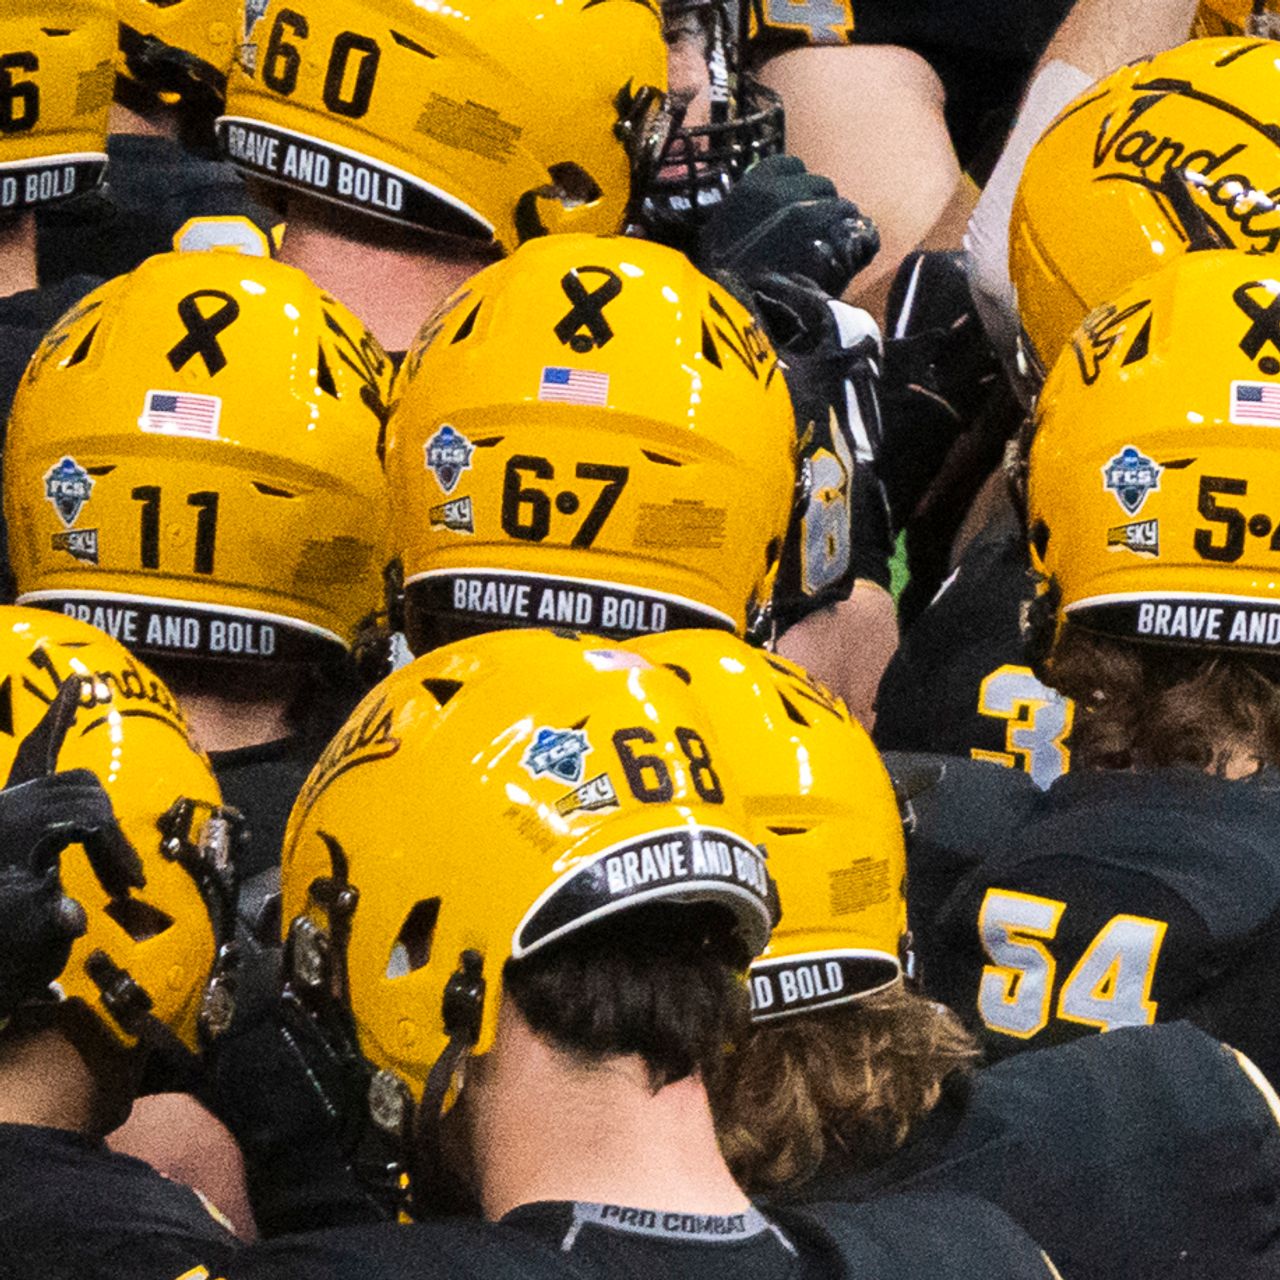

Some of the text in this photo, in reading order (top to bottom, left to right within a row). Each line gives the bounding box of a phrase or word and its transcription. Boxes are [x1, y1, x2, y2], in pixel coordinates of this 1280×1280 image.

[262, 7, 381, 119] 60
[25, 166, 76, 202] BOLD
[227, 125, 403, 211] BRAVE AND BOLD
[1111, 469, 1151, 484] FCS
[131, 484, 220, 575] 11
[1126, 520, 1157, 545] SKY
[453, 578, 668, 632] BRAVE AND BOLD
[1137, 603, 1224, 641] BRAVE
[146, 616, 200, 649] AND
[209, 620, 275, 655] BOLD
[611, 725, 725, 805] 68
[605, 841, 688, 894] BRAVE
[693, 838, 733, 877] AND
[778, 961, 844, 1004] BOLD
[978, 887, 1169, 1040] 54
[600, 1205, 657, 1230] PRO
